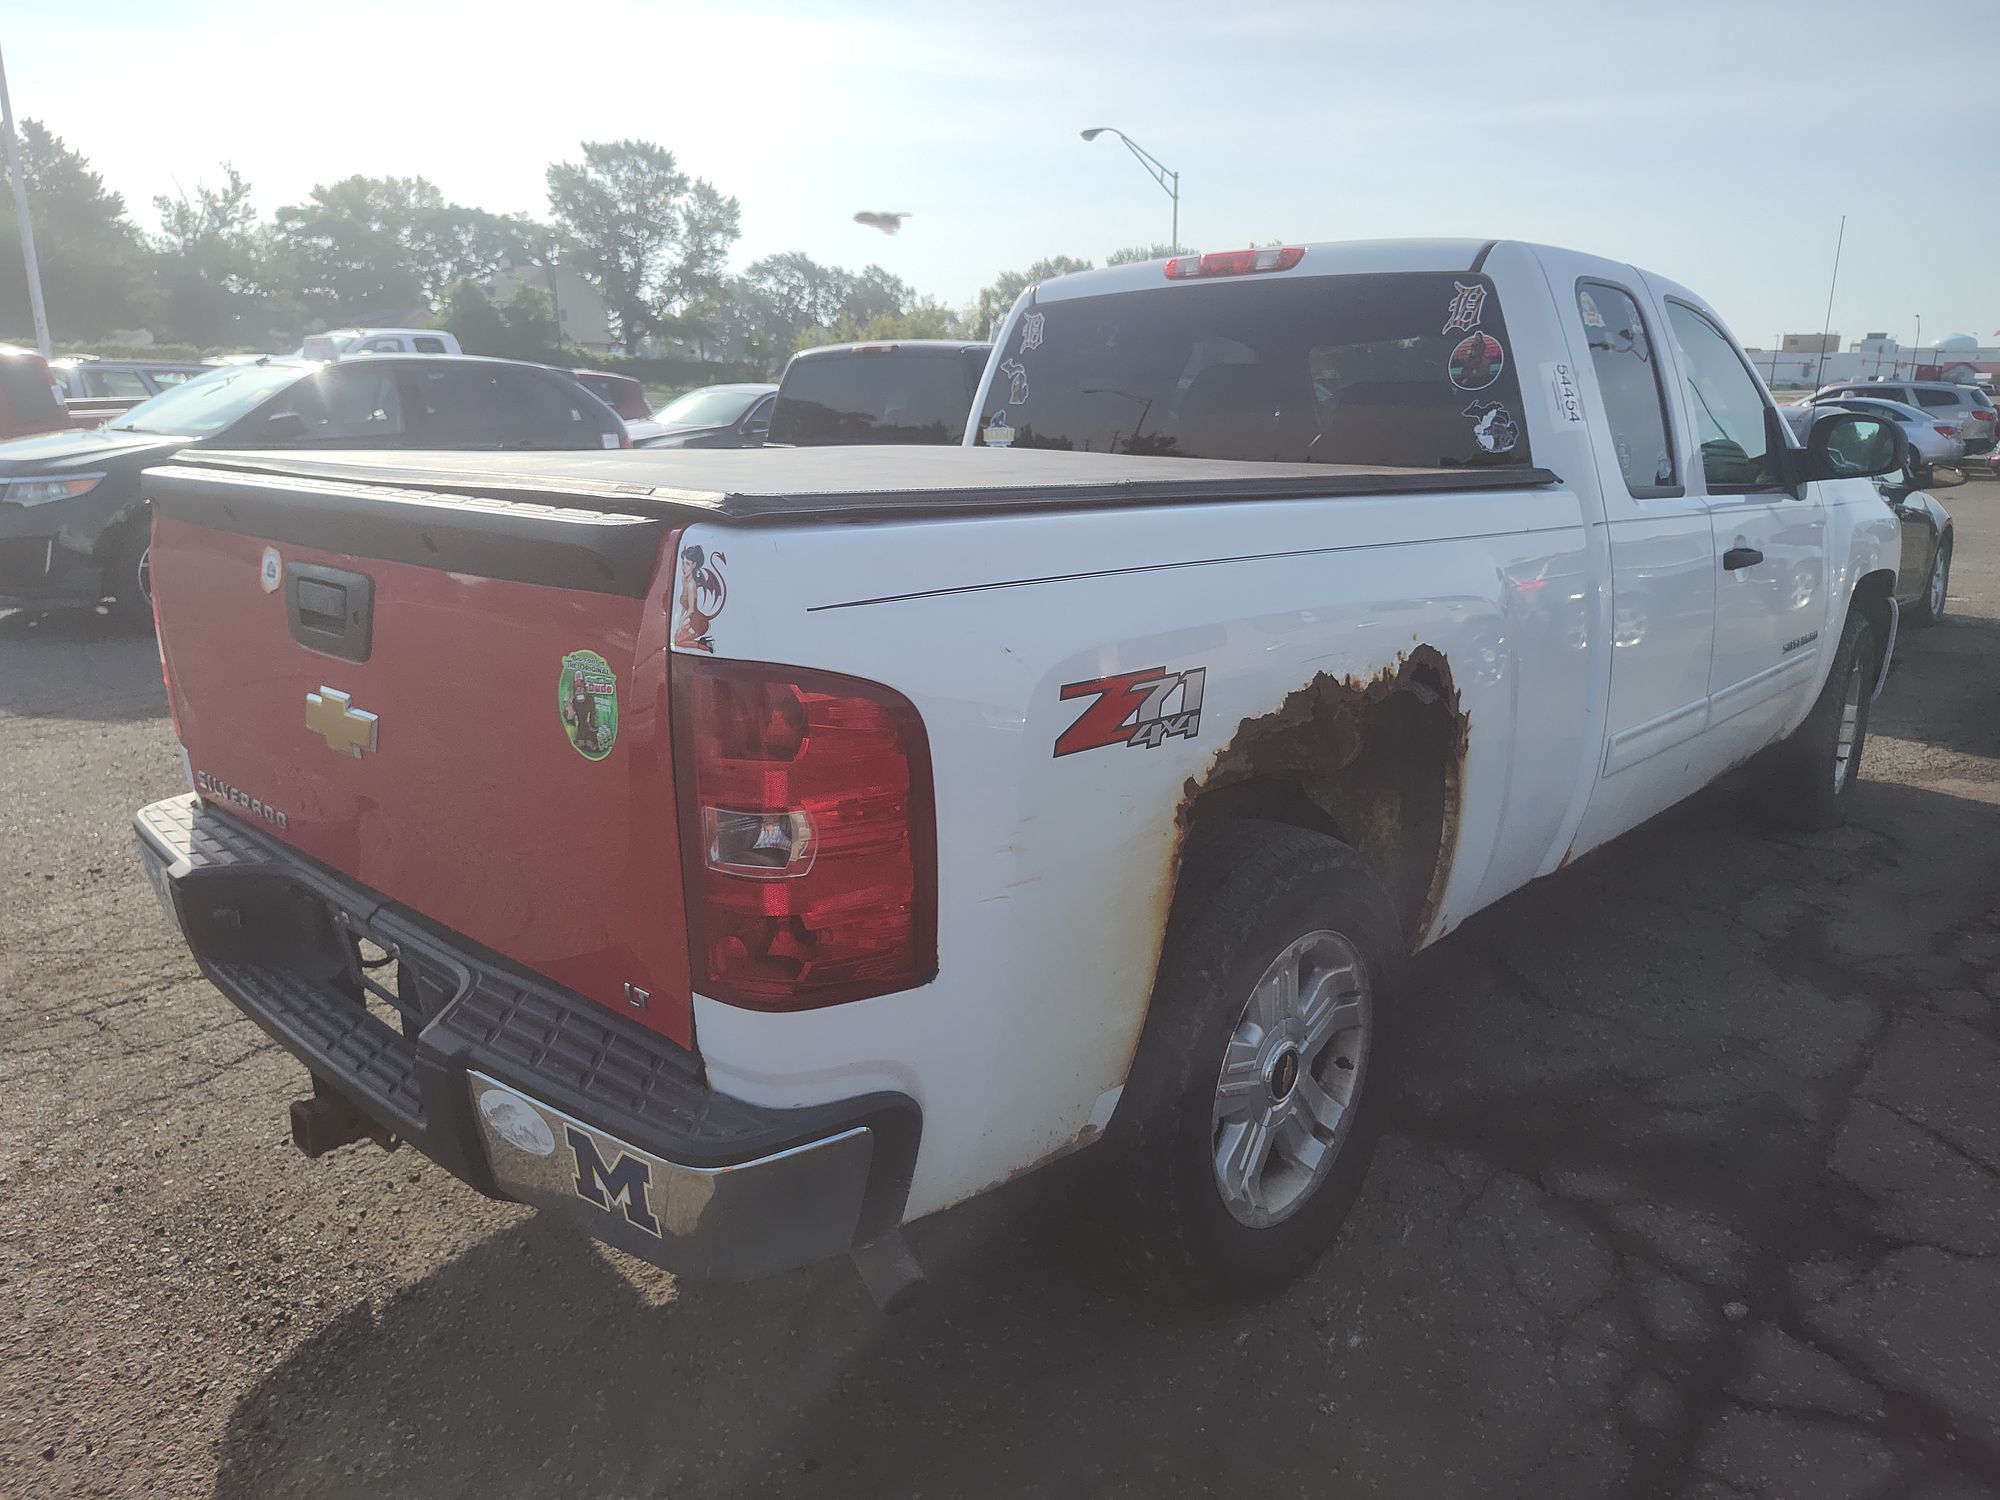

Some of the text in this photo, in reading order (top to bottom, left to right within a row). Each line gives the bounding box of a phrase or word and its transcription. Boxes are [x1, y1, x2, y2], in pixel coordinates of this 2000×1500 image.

[1556, 363, 1581, 423] 54454
[1053, 666, 1206, 758] Z71
[197, 769, 288, 832] SILVERADO
[624, 981, 651, 1009] LT
[563, 1122, 662, 1239] M
